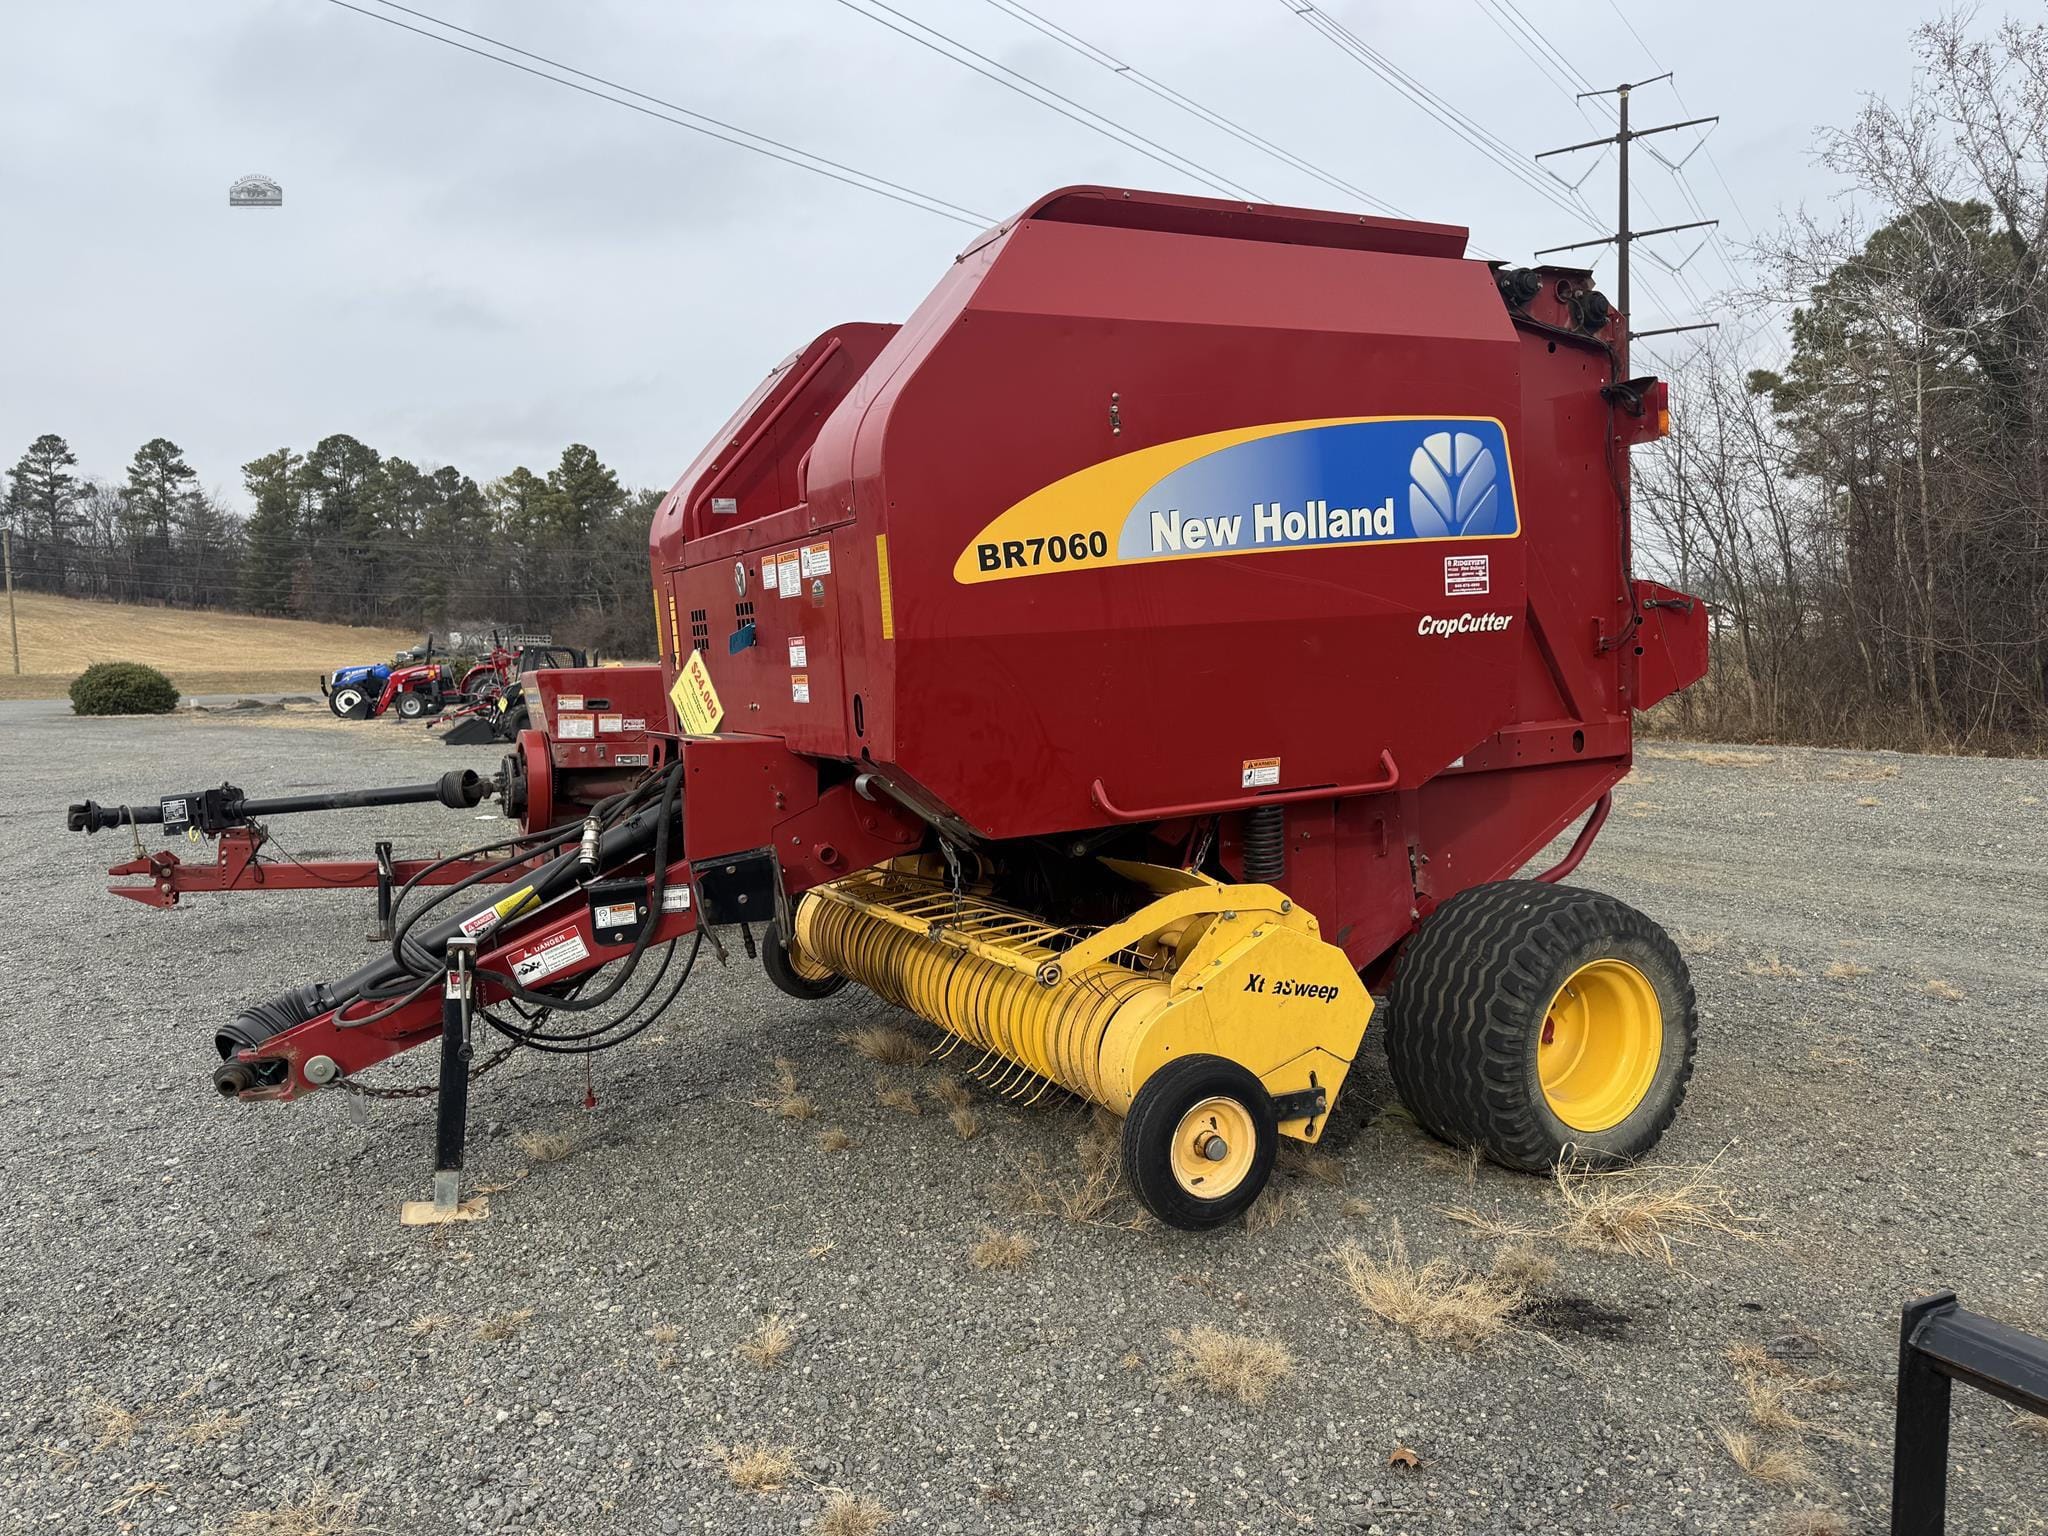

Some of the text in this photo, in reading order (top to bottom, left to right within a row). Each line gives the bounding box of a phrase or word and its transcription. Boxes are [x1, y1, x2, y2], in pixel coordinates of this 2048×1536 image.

[1150, 497, 1395, 552] New Holland
[977, 531, 1108, 571] BR7060
[1418, 612, 1513, 639] CropCutter
[691, 661, 717, 719] $24,000
[473, 912, 494, 927] DANGER
[1244, 973, 1339, 1004] XtaSweep
